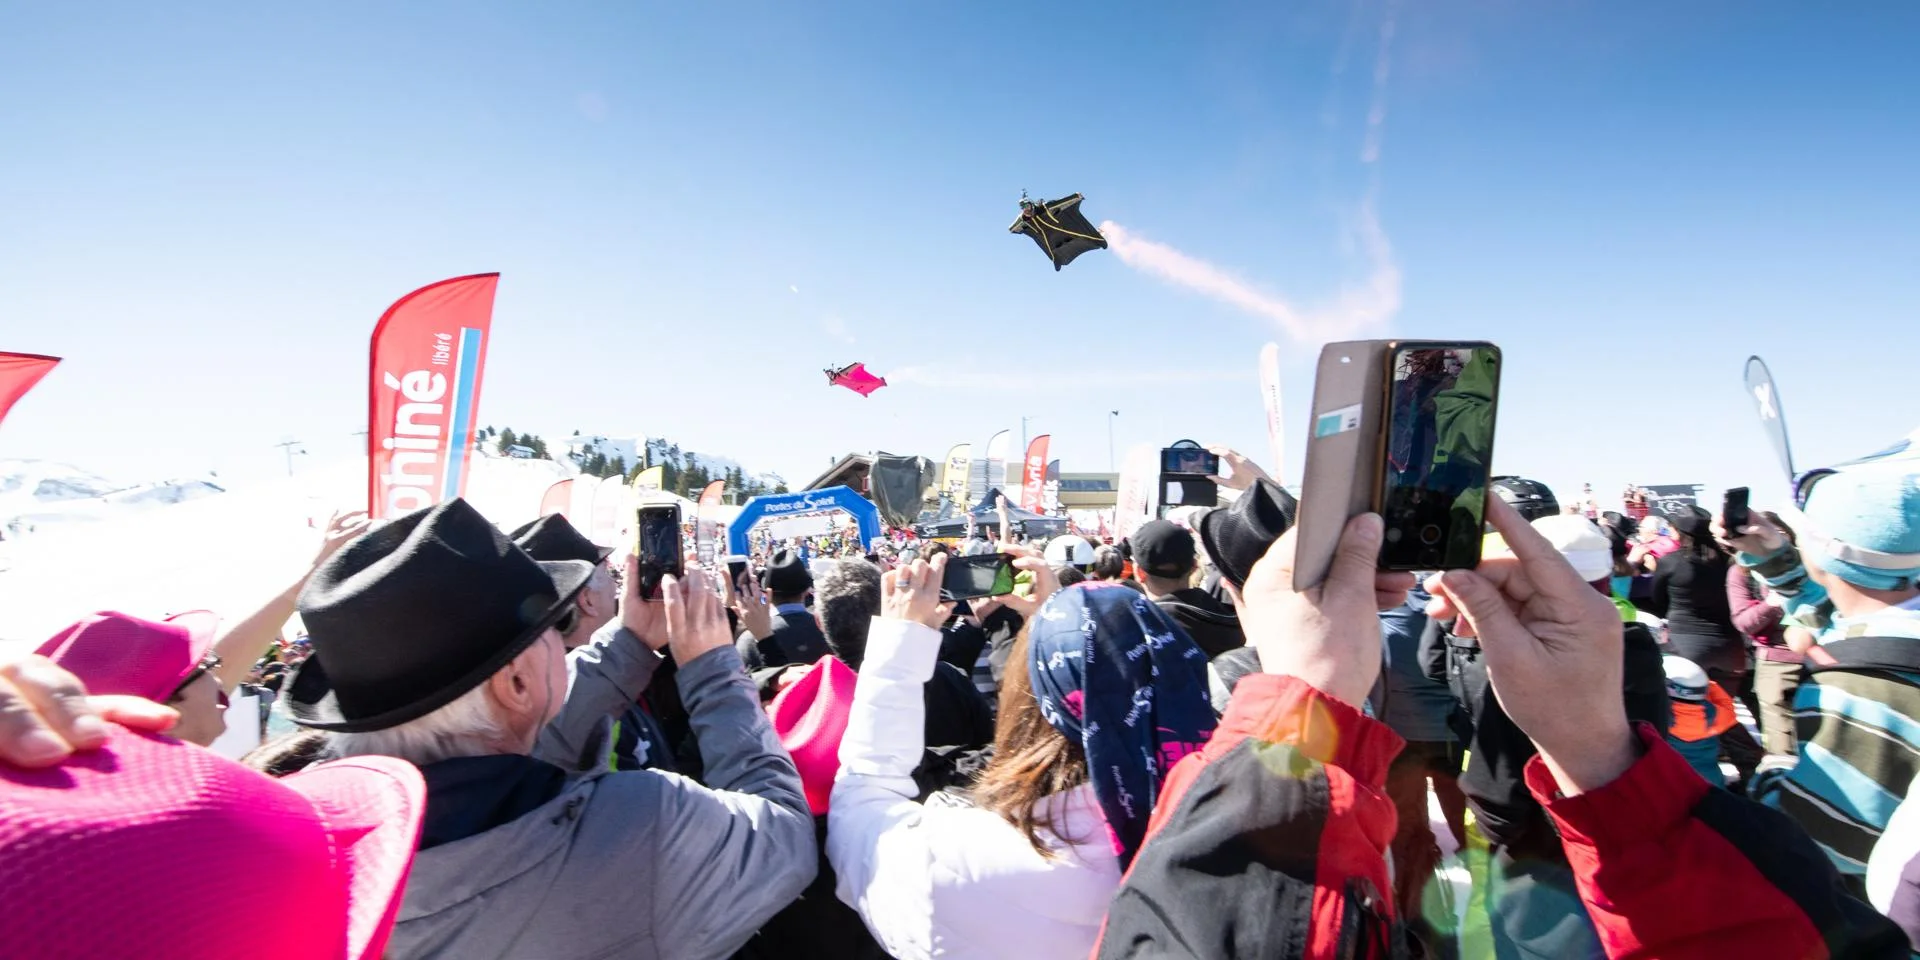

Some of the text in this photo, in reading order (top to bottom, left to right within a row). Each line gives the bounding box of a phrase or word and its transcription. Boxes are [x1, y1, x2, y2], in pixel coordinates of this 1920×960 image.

[432, 332, 452, 366] libéré
[1025, 456, 1043, 493] Lyria
[764, 494, 836, 513] Portes du Soleil
